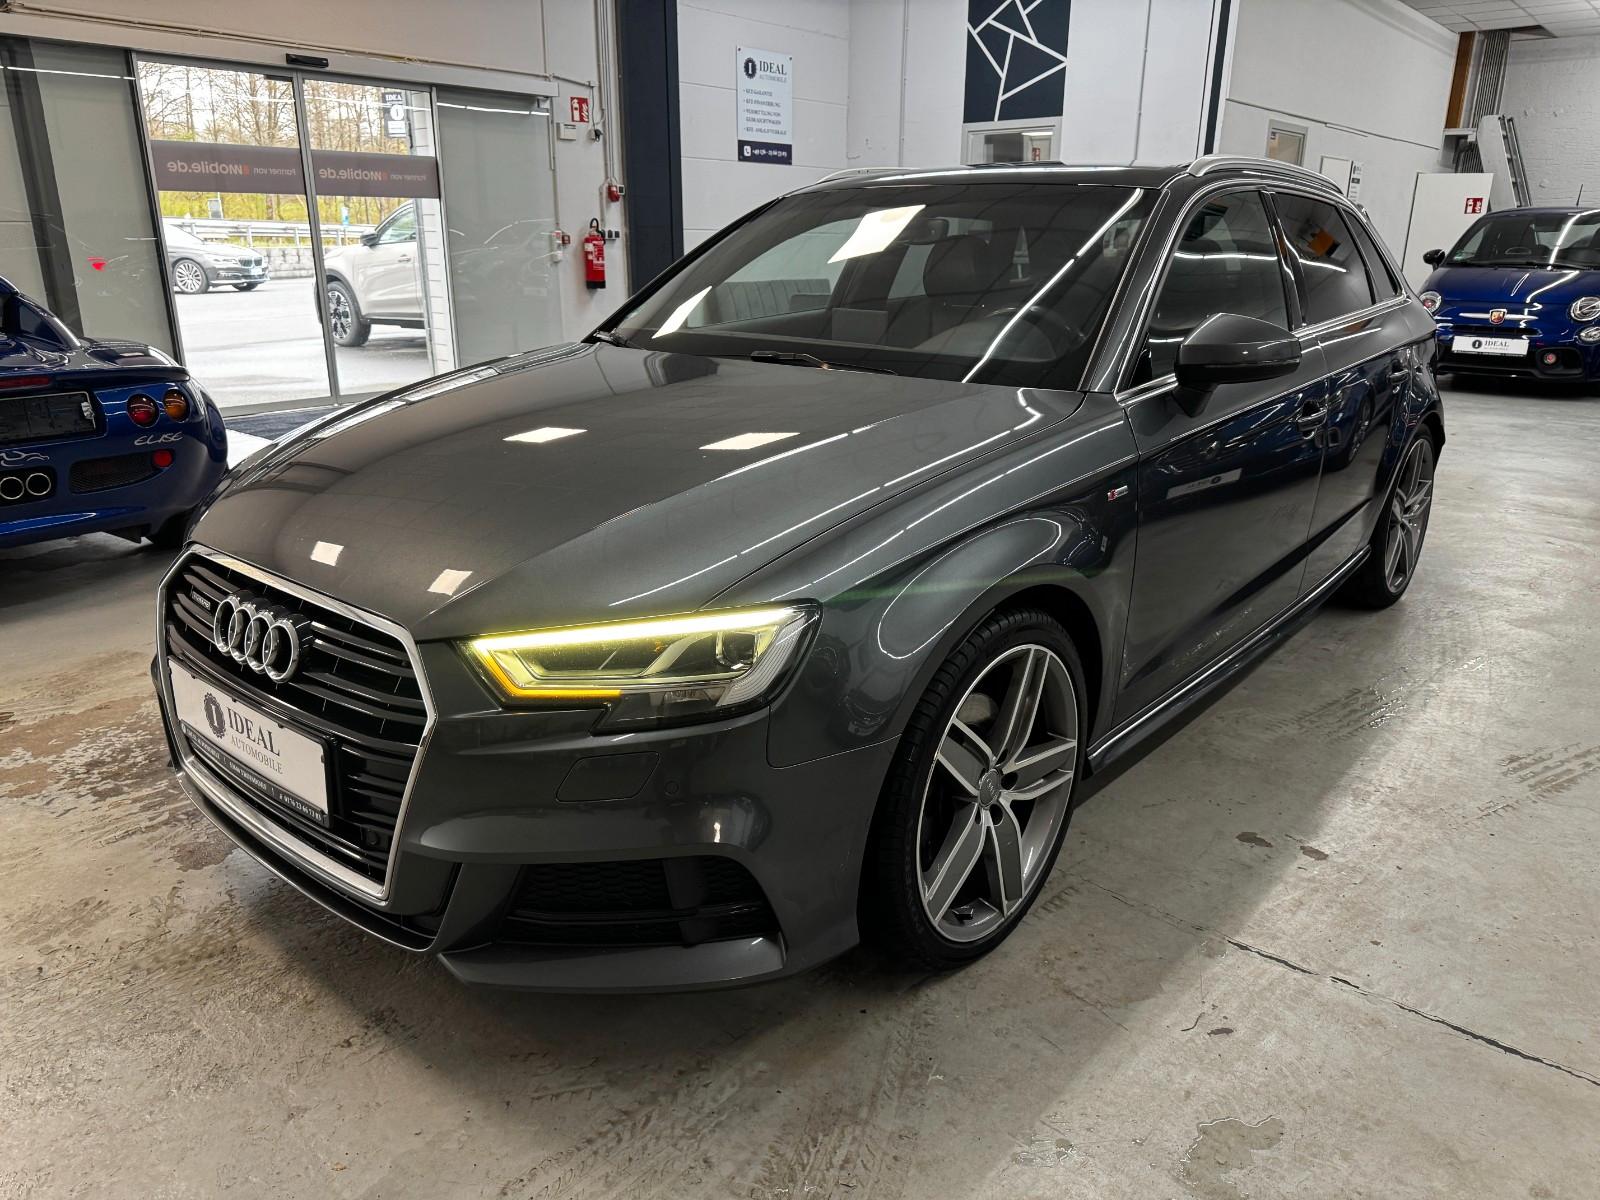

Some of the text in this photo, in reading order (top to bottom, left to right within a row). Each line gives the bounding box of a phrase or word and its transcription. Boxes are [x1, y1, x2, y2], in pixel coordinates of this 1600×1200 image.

[759, 60, 788, 76] IDEAL
[1484, 339, 1510, 348] IDEAL
[134, 432, 183, 446] ELISE
[227, 707, 281, 757] IDEAL
[231, 735, 283, 775] AUTOMOBILE
